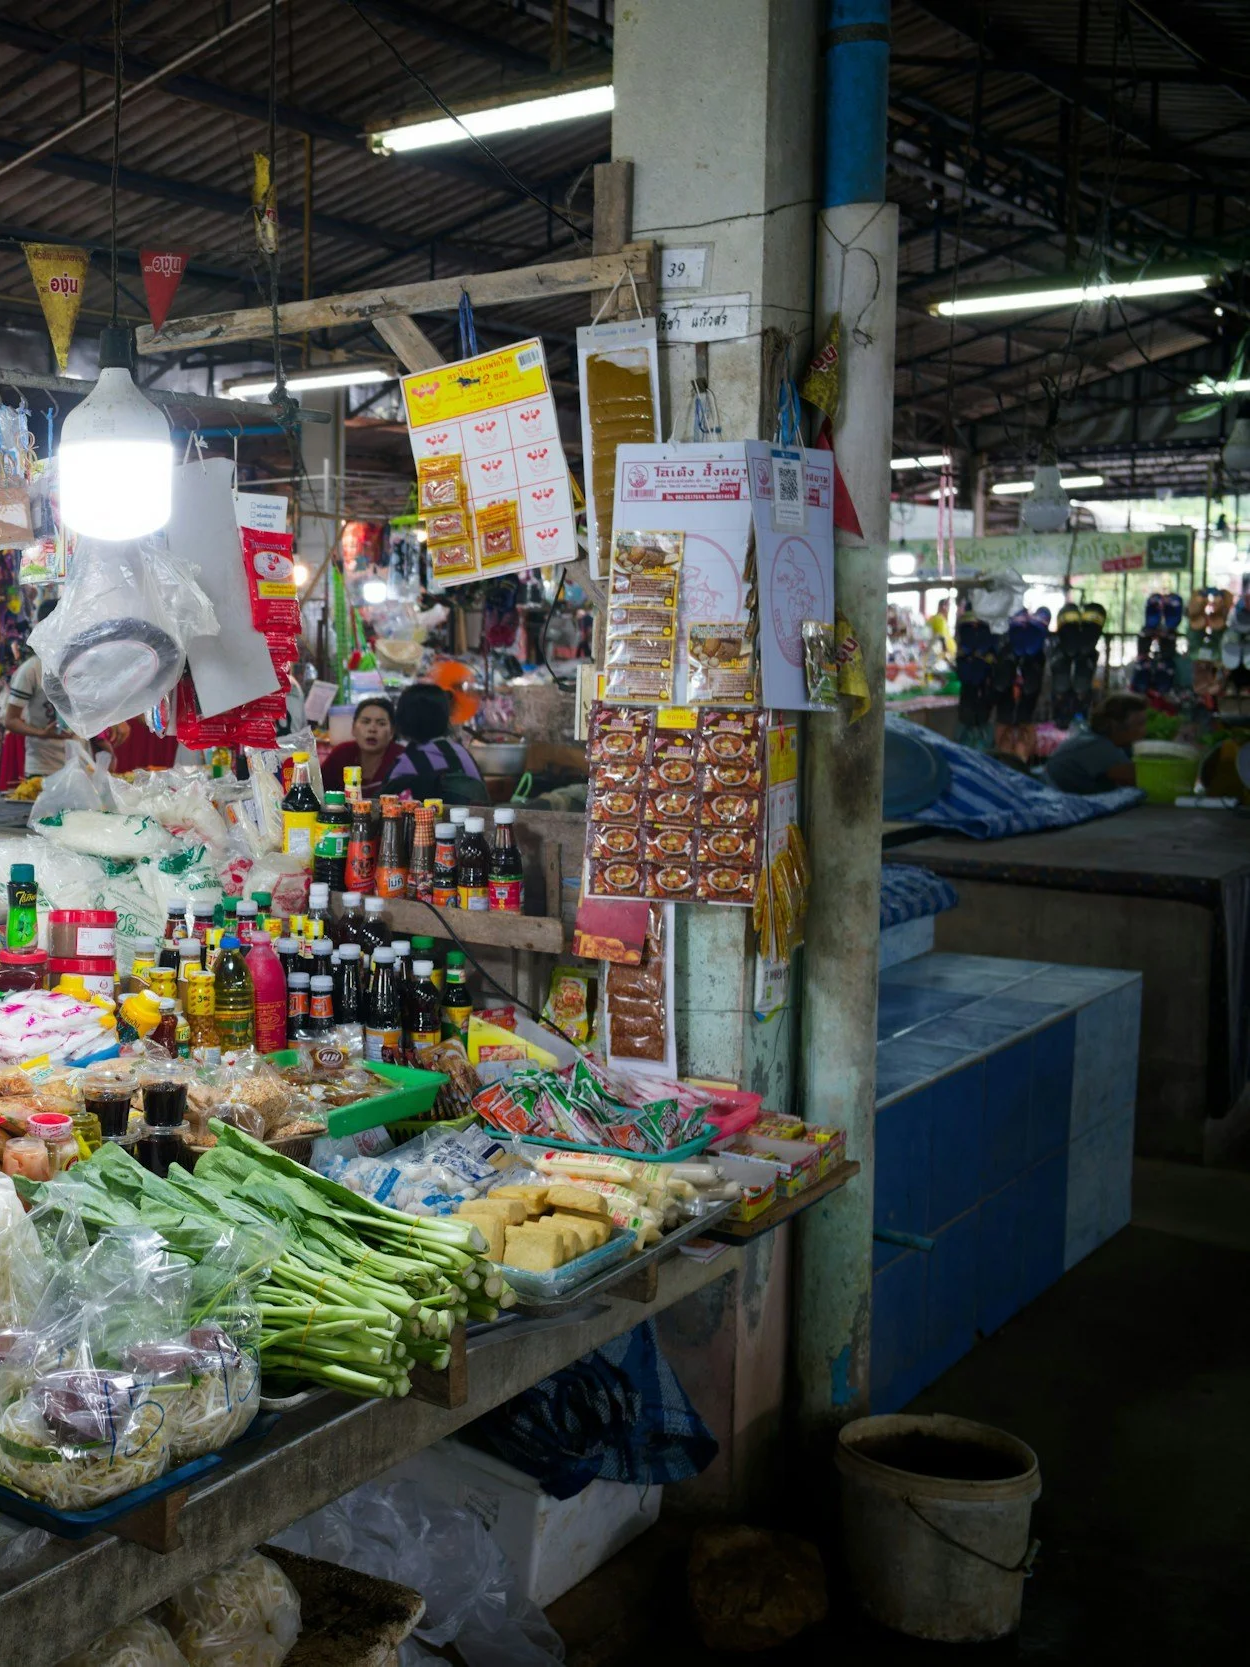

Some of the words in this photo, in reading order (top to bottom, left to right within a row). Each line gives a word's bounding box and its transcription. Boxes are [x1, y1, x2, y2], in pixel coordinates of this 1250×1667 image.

[667, 262, 686, 278] 39
[50, 271, 79, 298] องุ่น
[104, 1379, 166, 1467] 15
